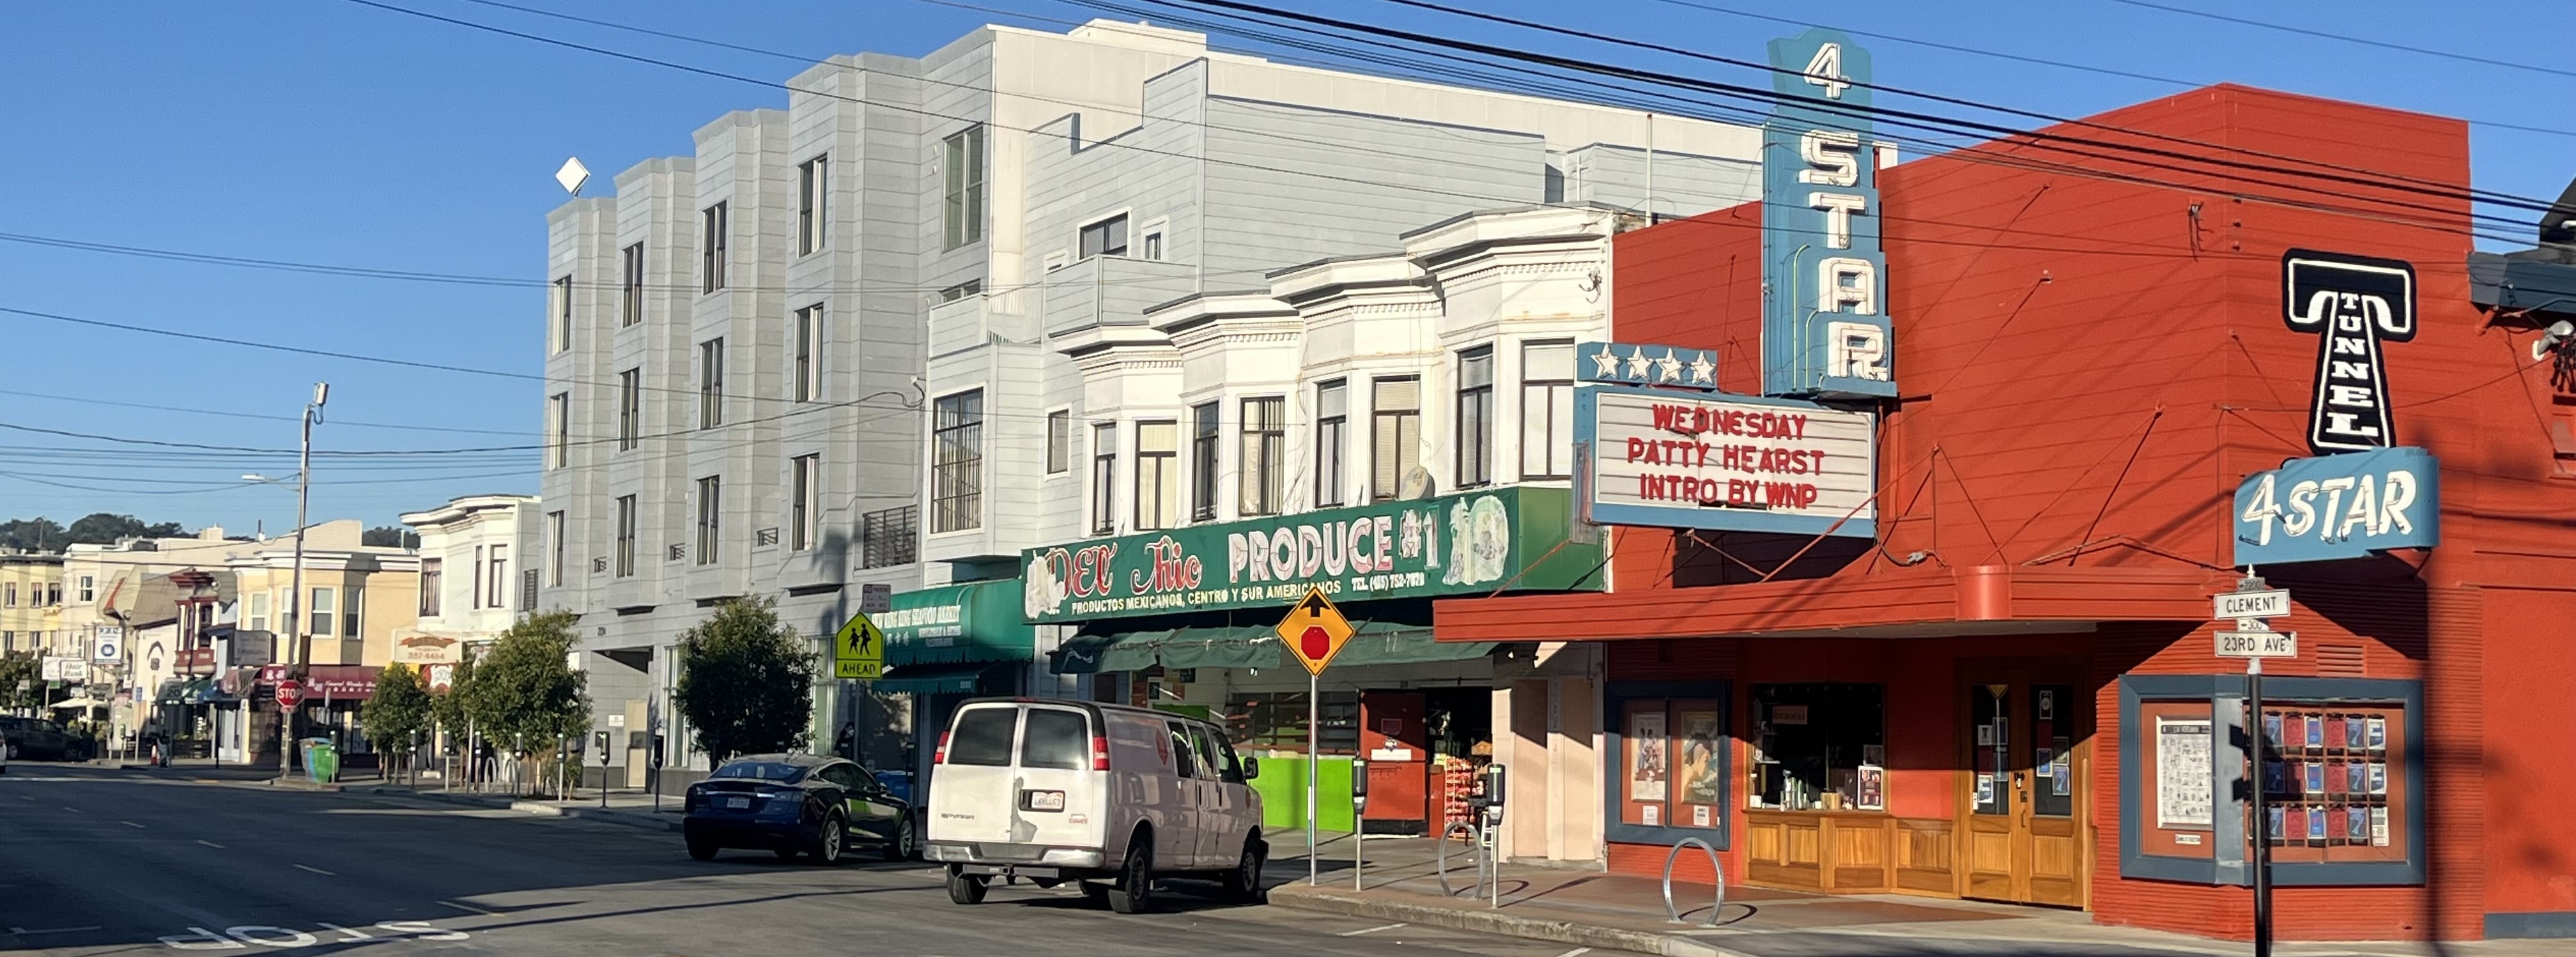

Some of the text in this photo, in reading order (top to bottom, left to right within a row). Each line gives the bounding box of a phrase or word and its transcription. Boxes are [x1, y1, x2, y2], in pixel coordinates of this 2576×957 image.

[1798, 42, 1889, 381] 4 STAR
[2325, 291, 2379, 438] TUNNEL
[1652, 403, 1807, 440] WEDNESDAY
[1627, 436, 1825, 477] PATTY HEARST
[1640, 473, 1818, 510] INTRO BY WNP
[2241, 470, 2417, 546] 4 STAR
[1228, 516, 1394, 584] PRODUCE
[1399, 509, 1441, 569] #1
[1071, 597, 1125, 615] PRODUCTOS
[1126, 593, 1185, 611] MEXICANOS,
[1187, 588, 1228, 605] CENTRO
[1232, 588, 1238, 601] Y
[1241, 585, 1263, 602] SUR
[2226, 596, 2277, 613] CLEMENT
[2223, 636, 2286, 652] 23RD AVE
[842, 659, 876, 675] AHEAD
[278, 687, 304, 700] STOP
